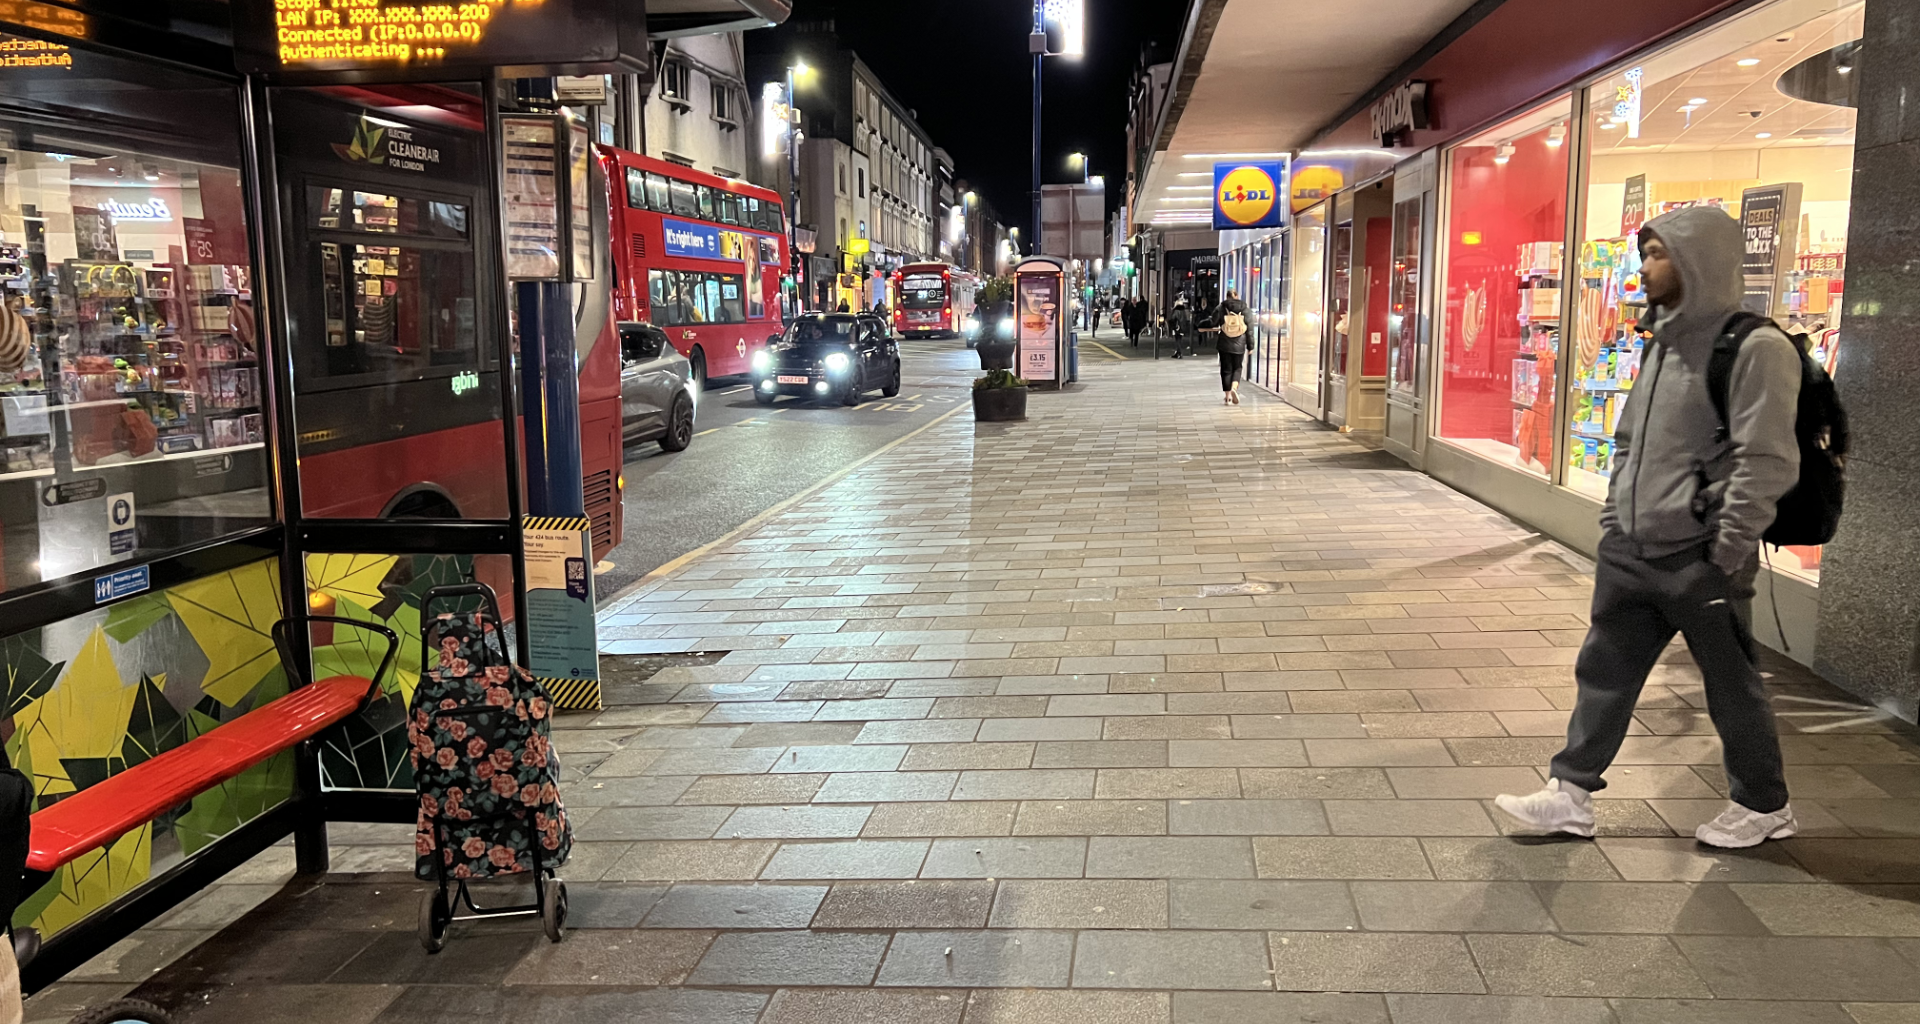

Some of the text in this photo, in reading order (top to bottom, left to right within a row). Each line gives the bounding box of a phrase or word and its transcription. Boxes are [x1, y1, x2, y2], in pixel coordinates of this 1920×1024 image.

[276, 11, 307, 26] LAN
[314, 9, 340, 25] IP:
[278, 23, 481, 42] Connected (IP:0.0.0.0)
[280, 43, 410, 60] Authenticating
[388, 128, 413, 141] ELECTRIC
[389, 158, 425, 172] FOR LONDON
[1749, 210, 1773, 224] DEALS
[1747, 226, 1773, 240] TO THE
[1029, 353, 1047, 362] £3.15
[114, 574, 132, 584] Priority
